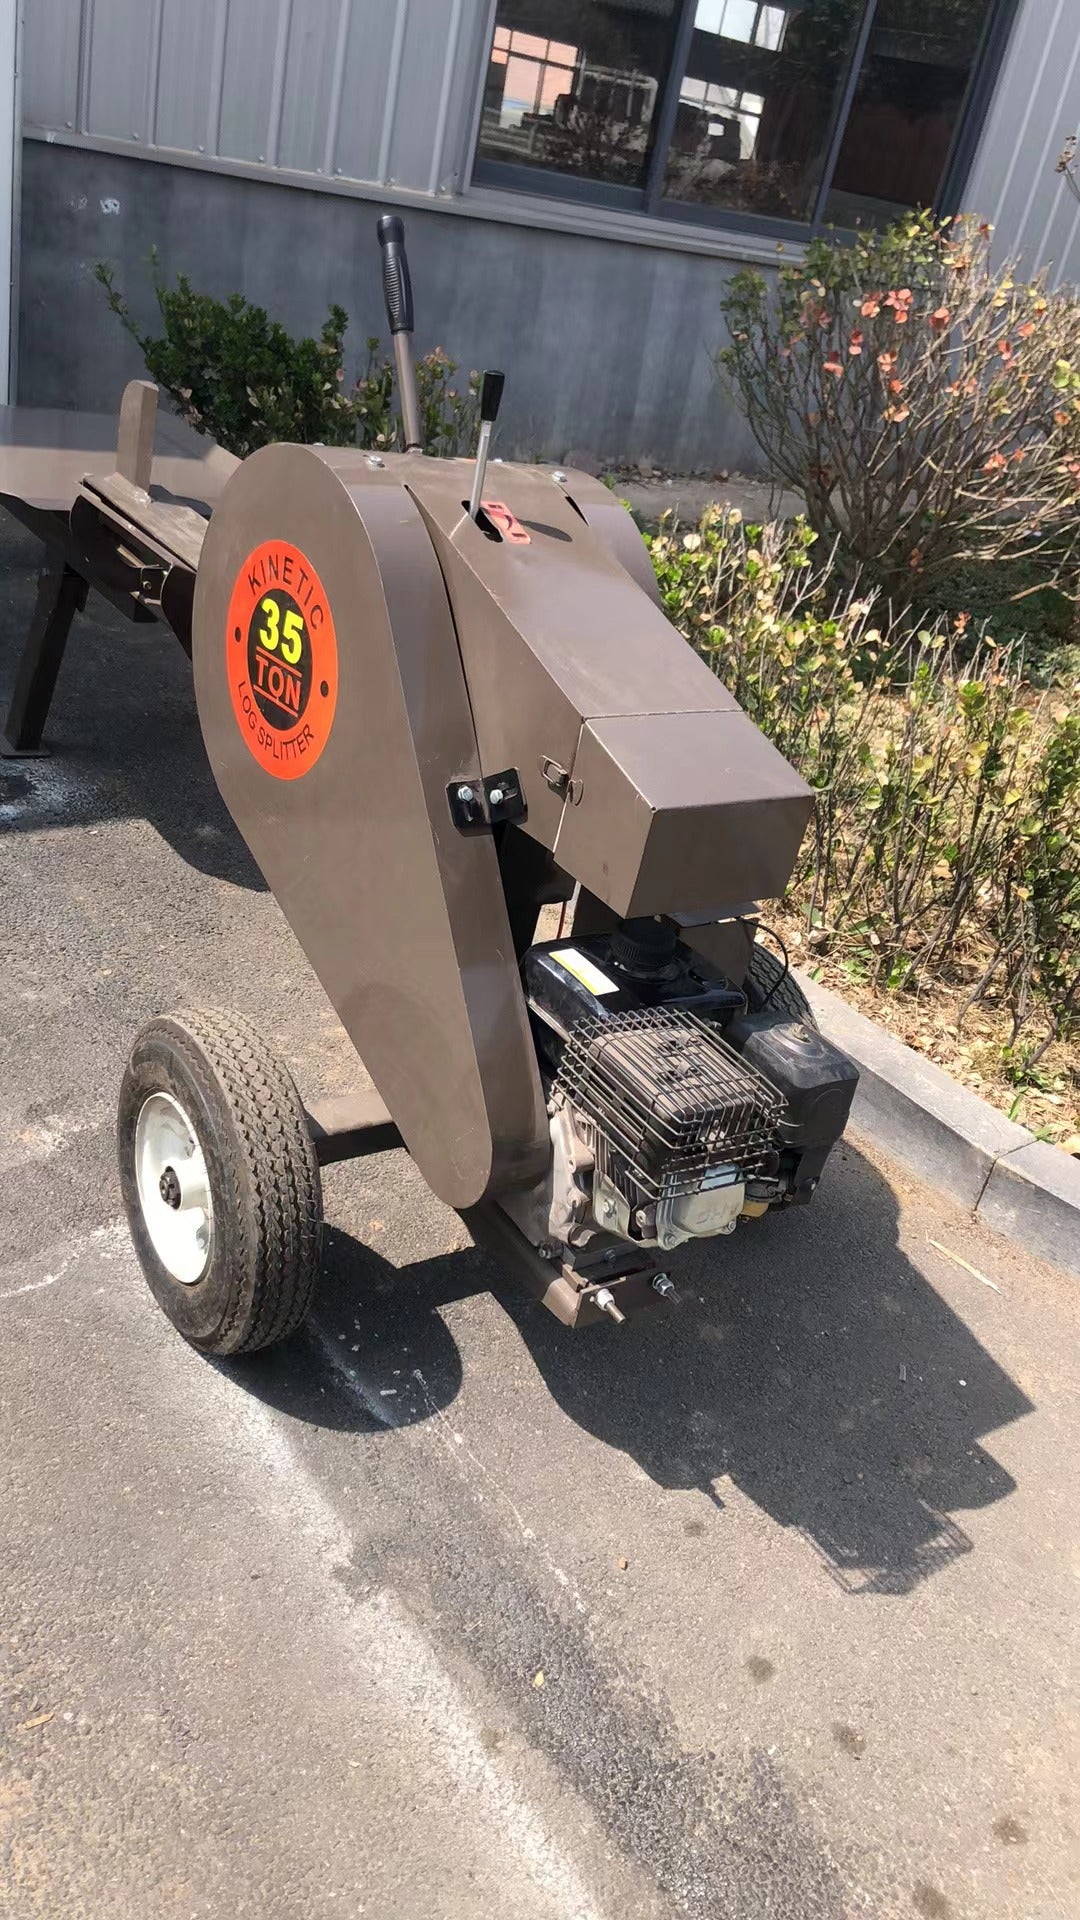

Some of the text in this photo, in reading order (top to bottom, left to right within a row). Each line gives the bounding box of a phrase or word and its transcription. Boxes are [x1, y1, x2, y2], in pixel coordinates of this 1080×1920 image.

[248, 554, 324, 630] KINETIC
[259, 597, 304, 665] 35
[255, 653, 301, 712] TON
[239, 681, 315, 761] LOG SPLITTER
